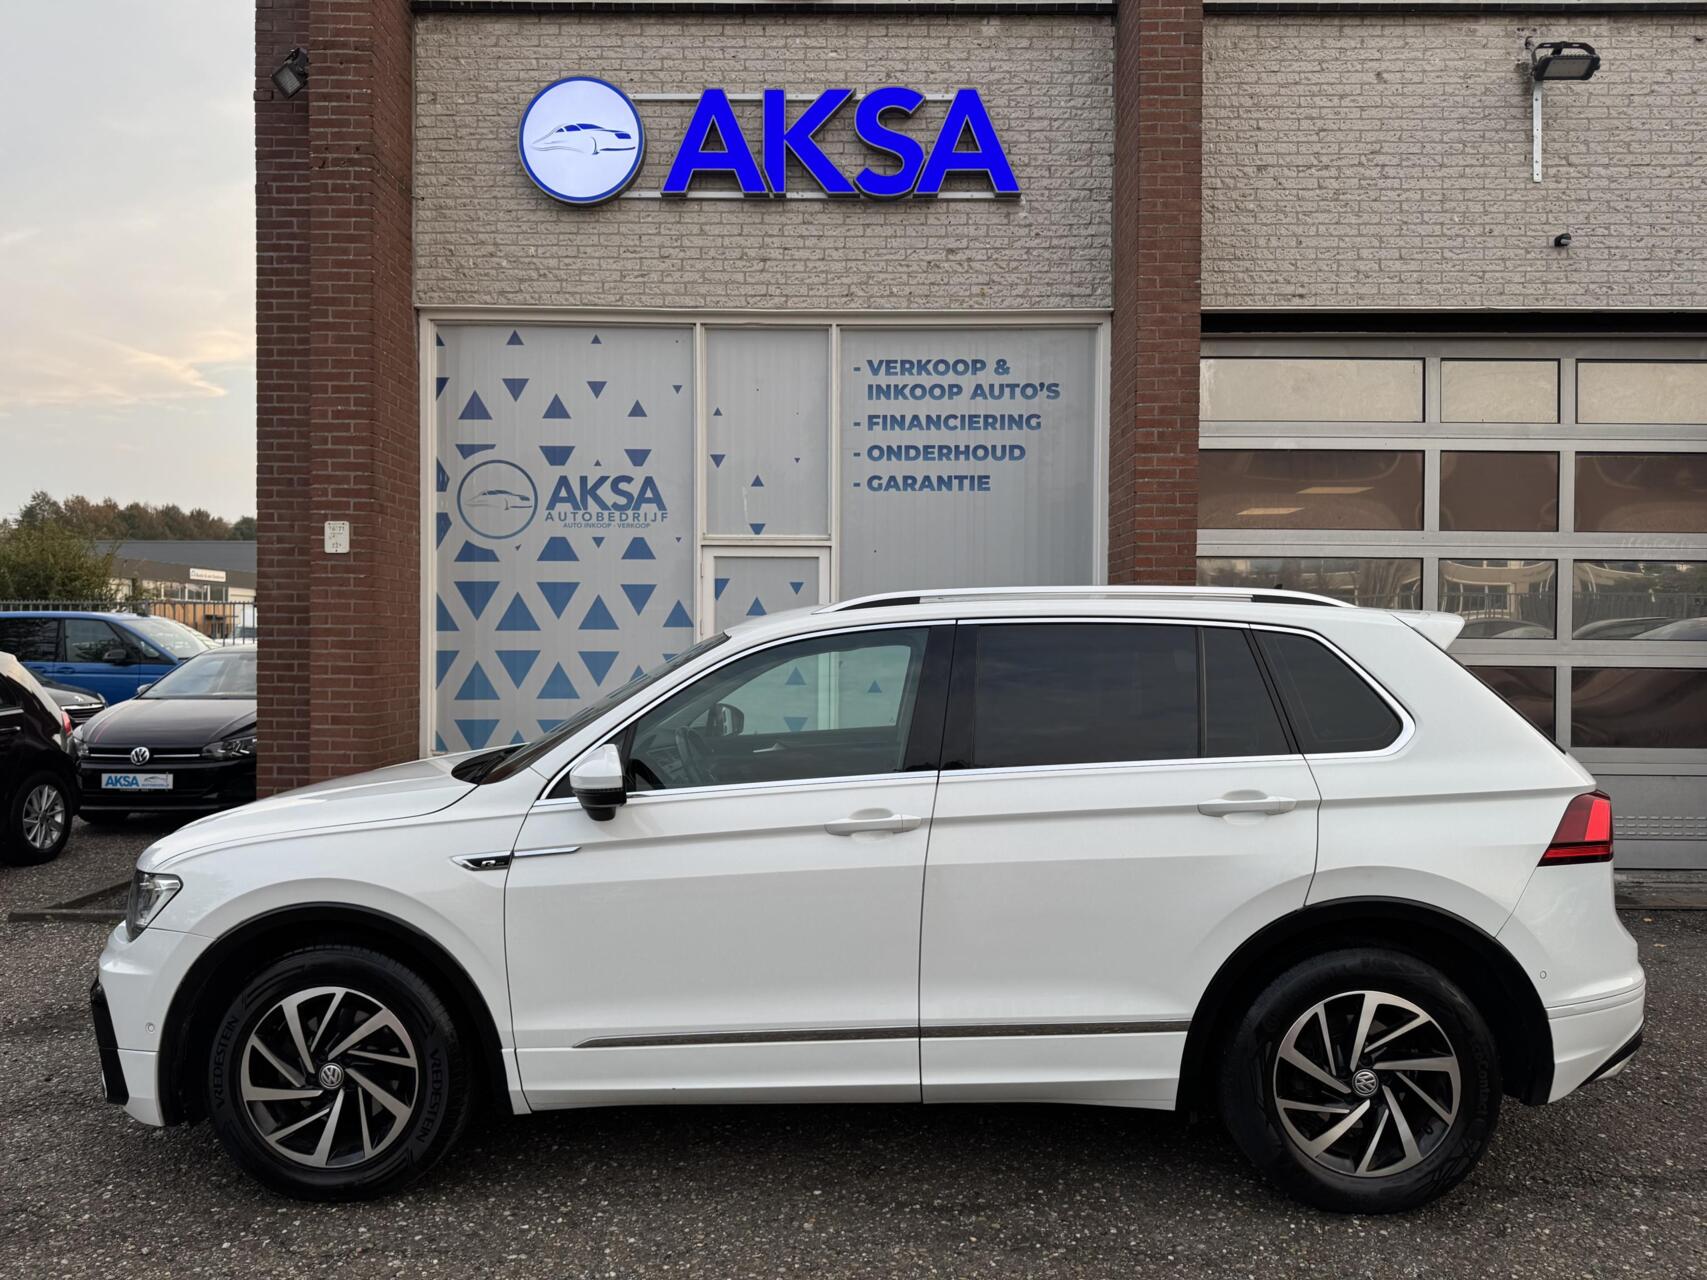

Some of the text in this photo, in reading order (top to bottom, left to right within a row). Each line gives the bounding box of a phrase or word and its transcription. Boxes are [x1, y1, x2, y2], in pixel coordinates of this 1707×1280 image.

[660, 86, 1022, 198] AKSA
[866, 359, 987, 376] VERKOOP
[993, 358, 1011, 376] &
[867, 382, 1061, 401] INKOOP AUTO'S
[867, 414, 1042, 431] FINANCIERING
[866, 444, 1026, 462] ONDERHOUD
[866, 475, 991, 492] GARANTIE
[545, 475, 668, 511] AKSA
[544, 511, 669, 522] AUTOBEDRIJF
[105, 775, 139, 787] AKSA
[213, 1015, 240, 1108] VREDESTEIN
[416, 1048, 444, 1143] VREDESTEIN
